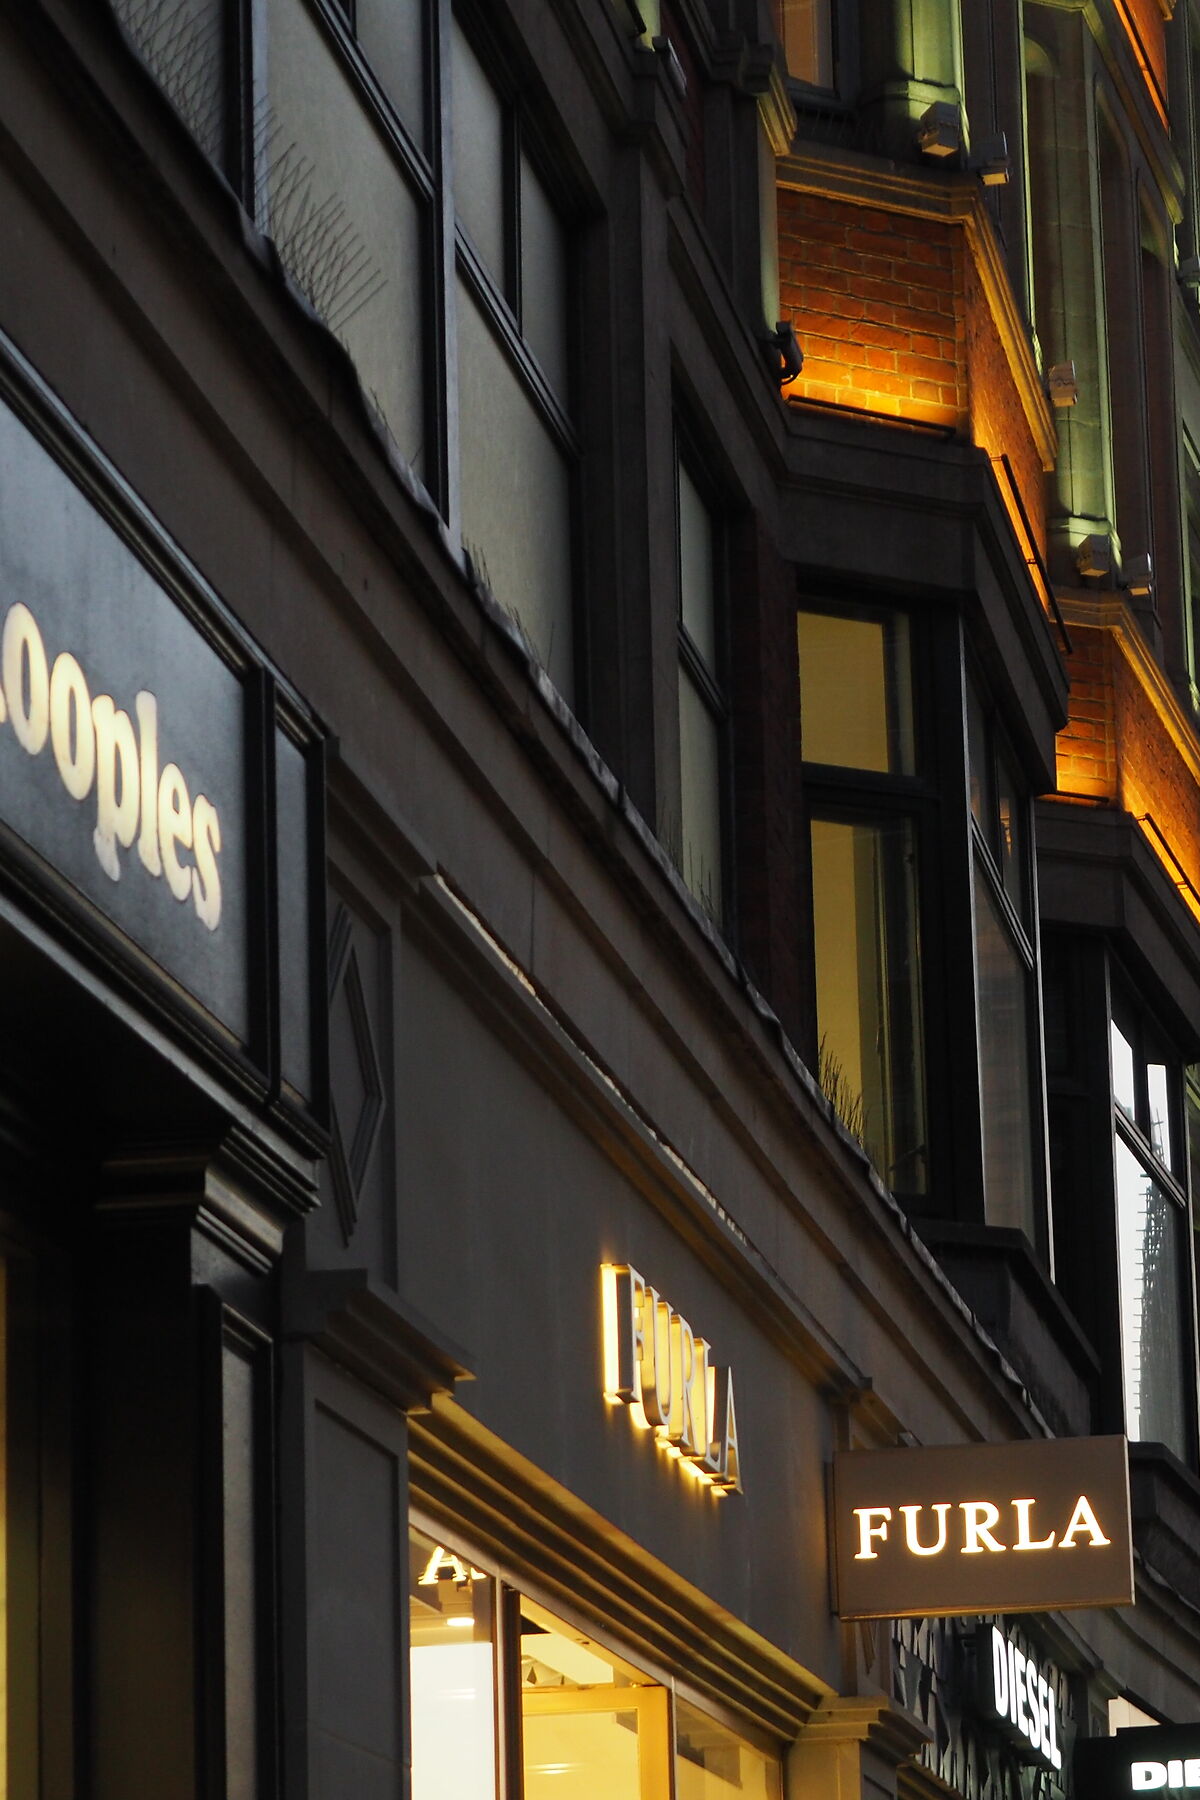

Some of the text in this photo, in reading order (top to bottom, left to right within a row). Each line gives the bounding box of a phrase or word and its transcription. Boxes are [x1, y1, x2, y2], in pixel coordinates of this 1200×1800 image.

[0, 602, 221, 931] ooples
[600, 1262, 743, 1496] FURLA
[853, 1495, 1111, 1559] FURLA
[991, 1625, 1062, 1770] DIESEL
